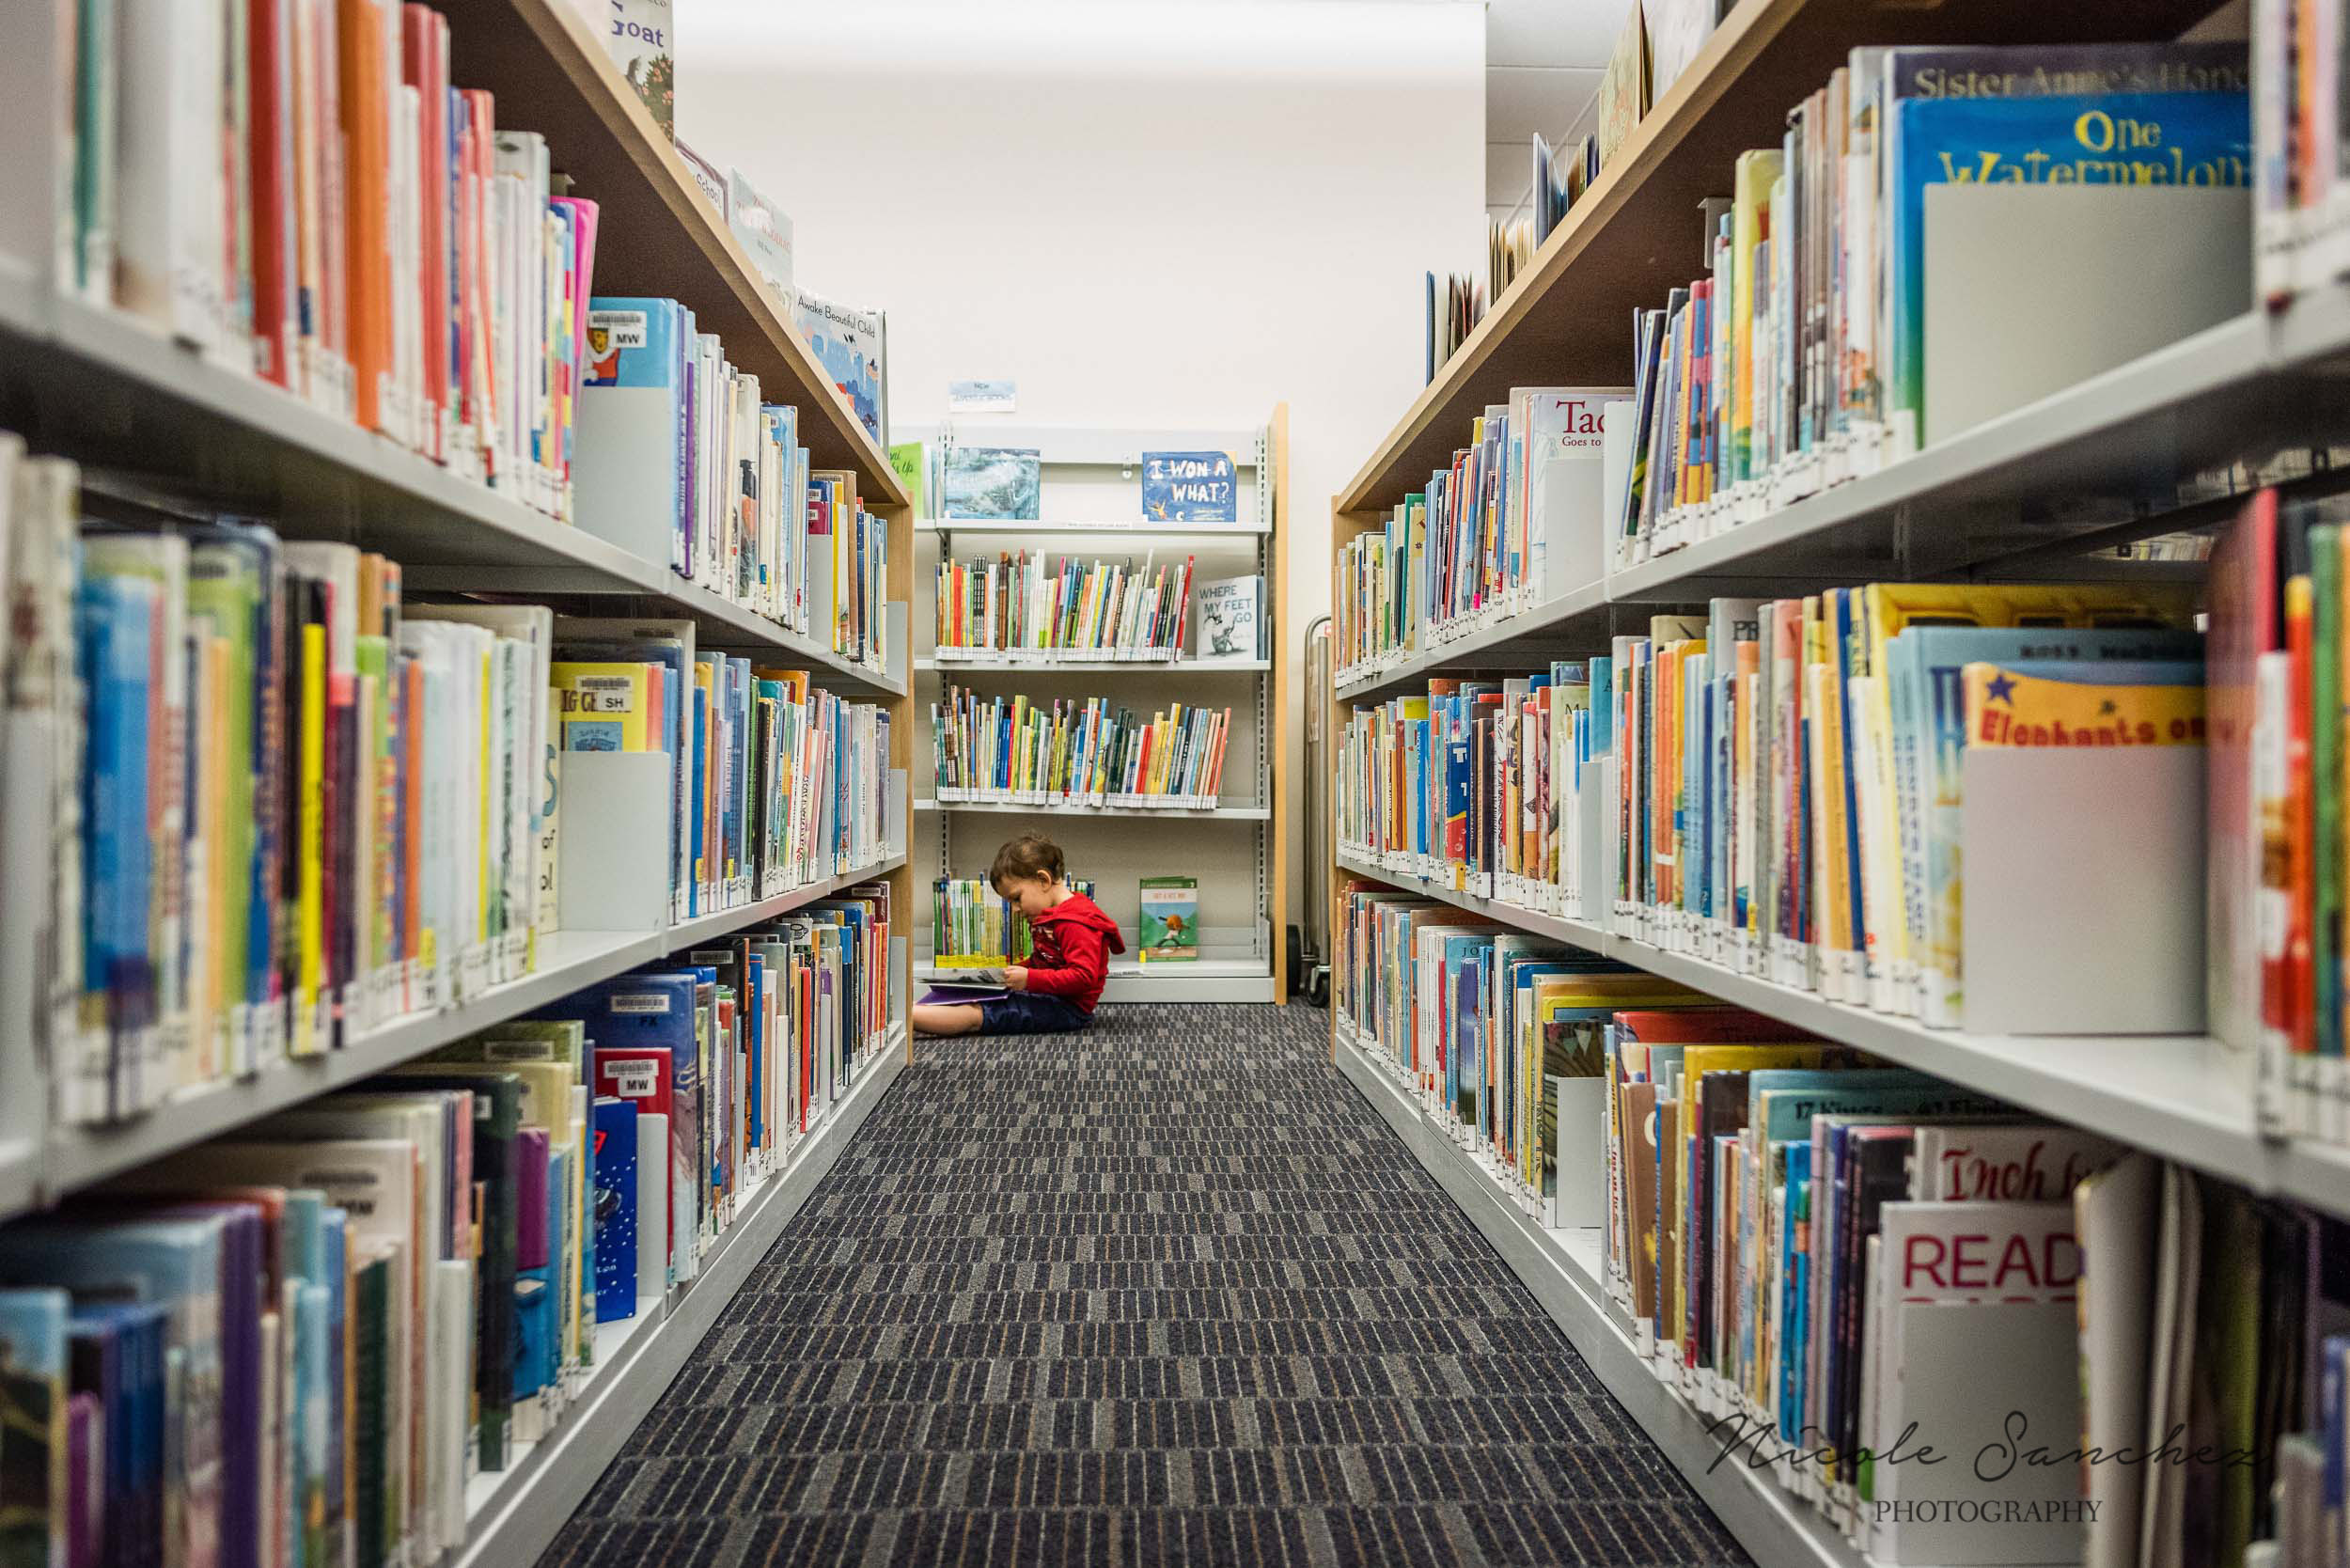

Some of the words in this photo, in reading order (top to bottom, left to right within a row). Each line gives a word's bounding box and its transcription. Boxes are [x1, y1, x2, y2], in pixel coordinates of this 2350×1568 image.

[1914, 66, 2014, 98] Sister
[2074, 110, 2162, 152] One
[798, 294, 822, 316] Awake
[825, 306, 856, 330] Beautiful
[857, 320, 876, 338] Child
[617, 334, 640, 344] MW
[1561, 435, 1588, 447] Goes
[1590, 437, 1602, 447] to
[1149, 460, 1164, 480] I
[1169, 458, 1209, 479] WON
[1214, 459, 1229, 477] A
[1171, 480, 1230, 505] WHAT?
[1199, 585, 1238, 600] WHERE
[1204, 602, 1221, 614] MY
[1224, 598, 1252, 612] FEET
[1234, 612, 1252, 623] GO
[604, 698, 624, 709] SH
[1980, 708, 2155, 746] Elephants
[627, 1079, 649, 1090] MW
[1942, 1141, 2046, 1202] Inch
[1902, 1233, 2081, 1290] READ
